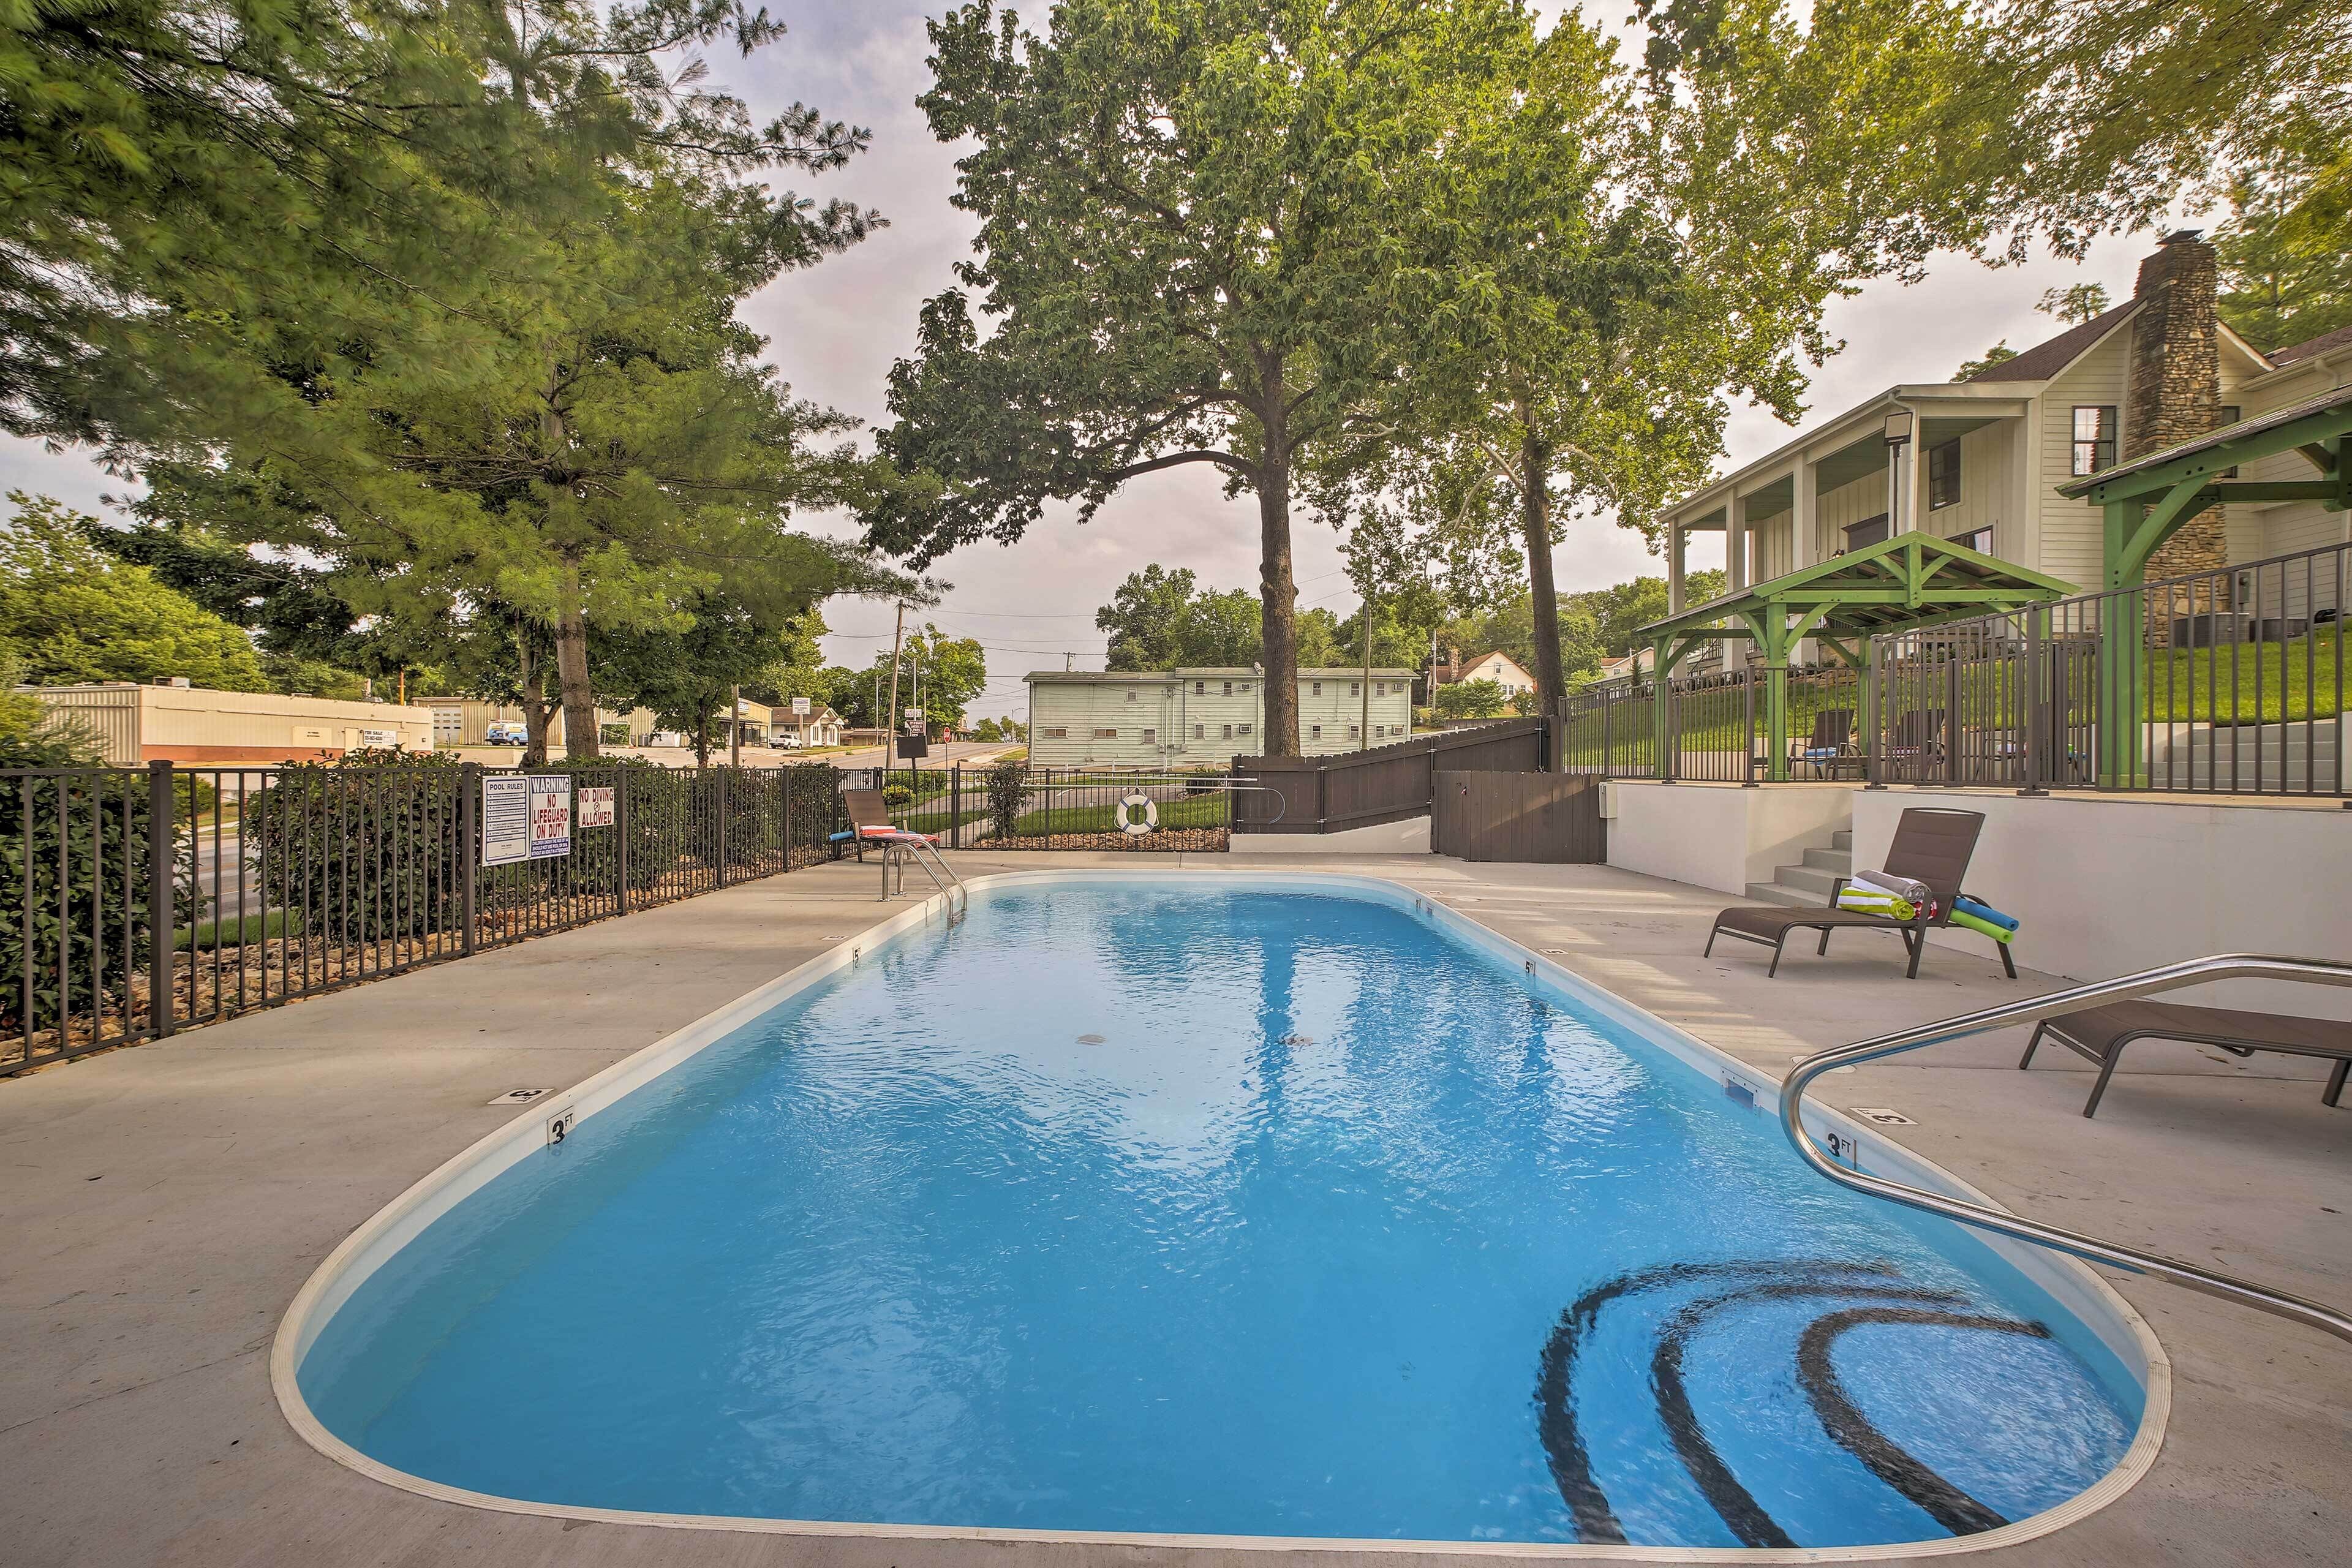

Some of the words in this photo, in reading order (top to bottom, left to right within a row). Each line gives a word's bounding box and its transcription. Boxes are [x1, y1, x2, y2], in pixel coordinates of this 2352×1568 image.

[532, 777, 569, 793] WARNING
[547, 794, 557, 808] NO
[579, 789, 589, 803] NO
[592, 788, 614, 802] DIVING
[533, 809, 568, 824] LIFEGUARD
[582, 811, 612, 826] ALLOWED
[537, 824, 546, 839] ON
[549, 823, 565, 837] DUTY
[1525, 961, 1530, 973] 5
[1871, 1115, 1907, 1123] 3
[552, 1120, 565, 1145] 3
[565, 1113, 573, 1126] FT
[1828, 1133, 1841, 1157] 3
[1841, 1139, 1851, 1153] FT
